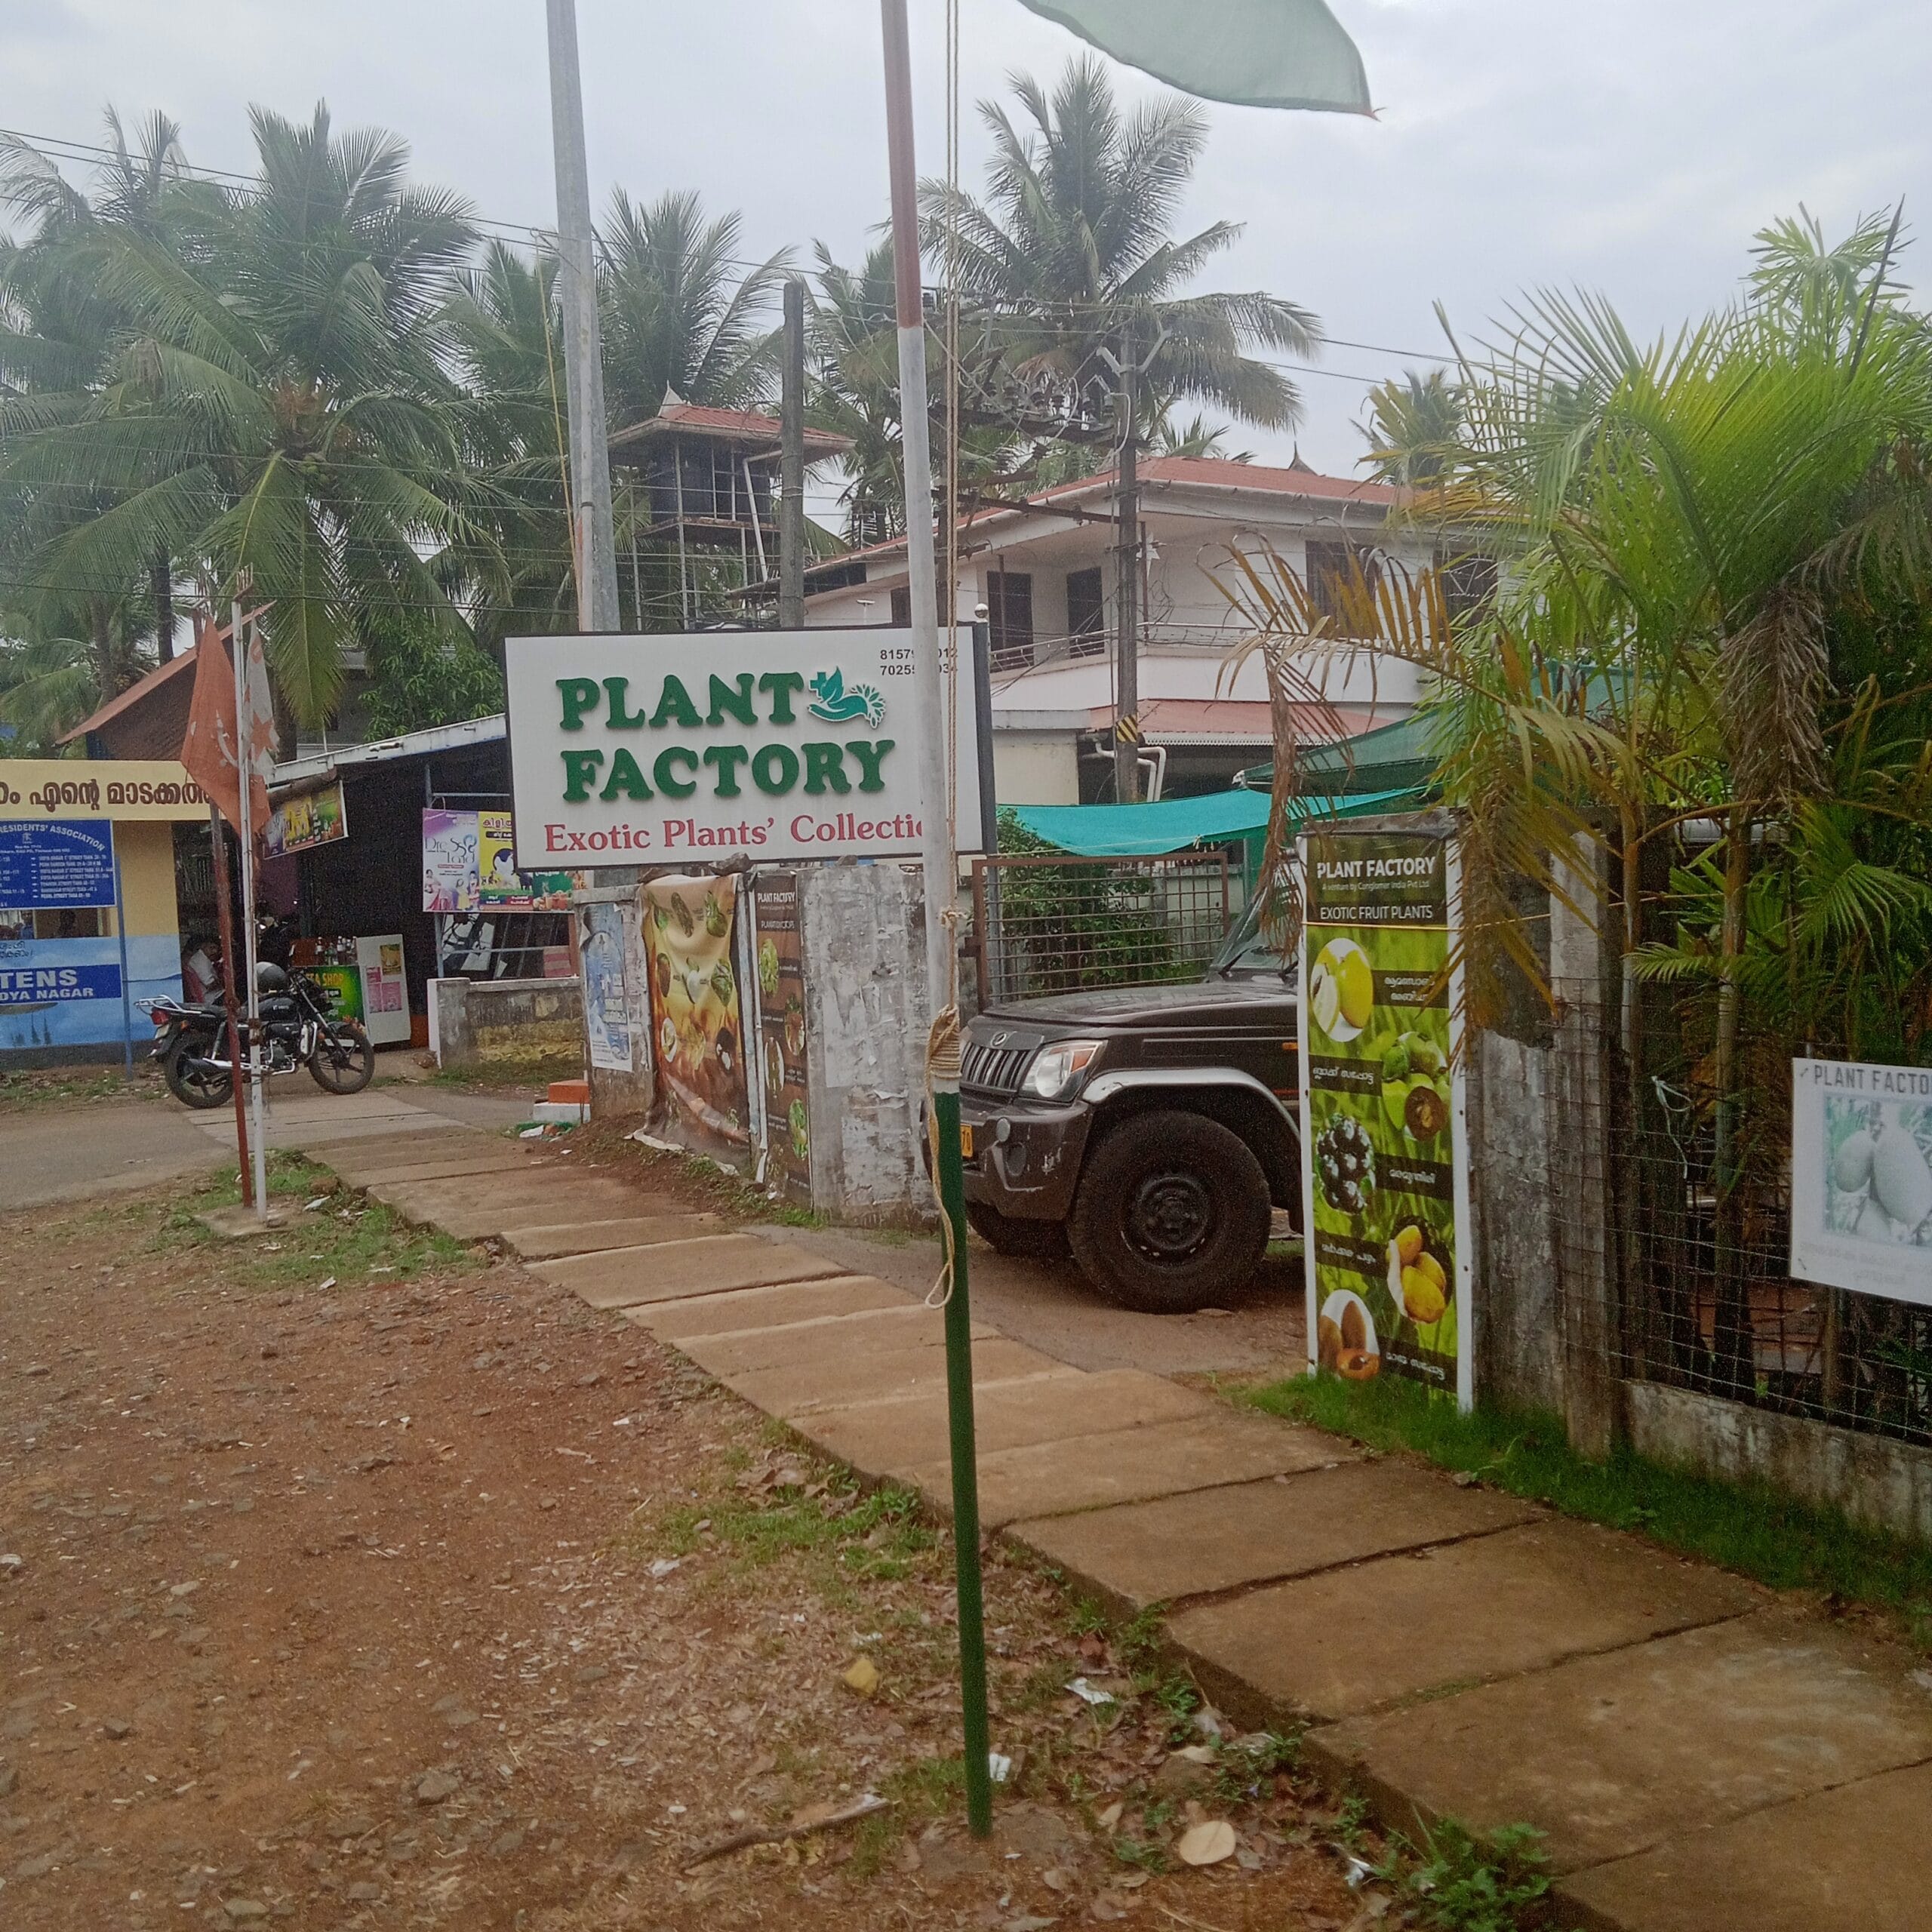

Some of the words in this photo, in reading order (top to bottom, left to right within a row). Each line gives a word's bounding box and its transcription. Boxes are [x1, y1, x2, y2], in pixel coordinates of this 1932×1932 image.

[555, 672, 804, 731] PLANT
[560, 740, 896, 801] FACTORY
[50, 825, 105, 851] ASSOCIATION
[544, 824, 651, 853] Exotic
[790, 813, 922, 844] Collecti
[1317, 860, 1364, 878] PLANT
[1366, 857, 1436, 877] FACTORY
[1321, 907, 1357, 920] EXOTIC
[1358, 906, 1389, 919] FRUIT
[1392, 906, 1433, 918] PLANTS
[36, 987, 94, 999] NAGAR
[1814, 1065, 1864, 1089] PLANT
[1872, 1070, 1932, 1094] FACTO
